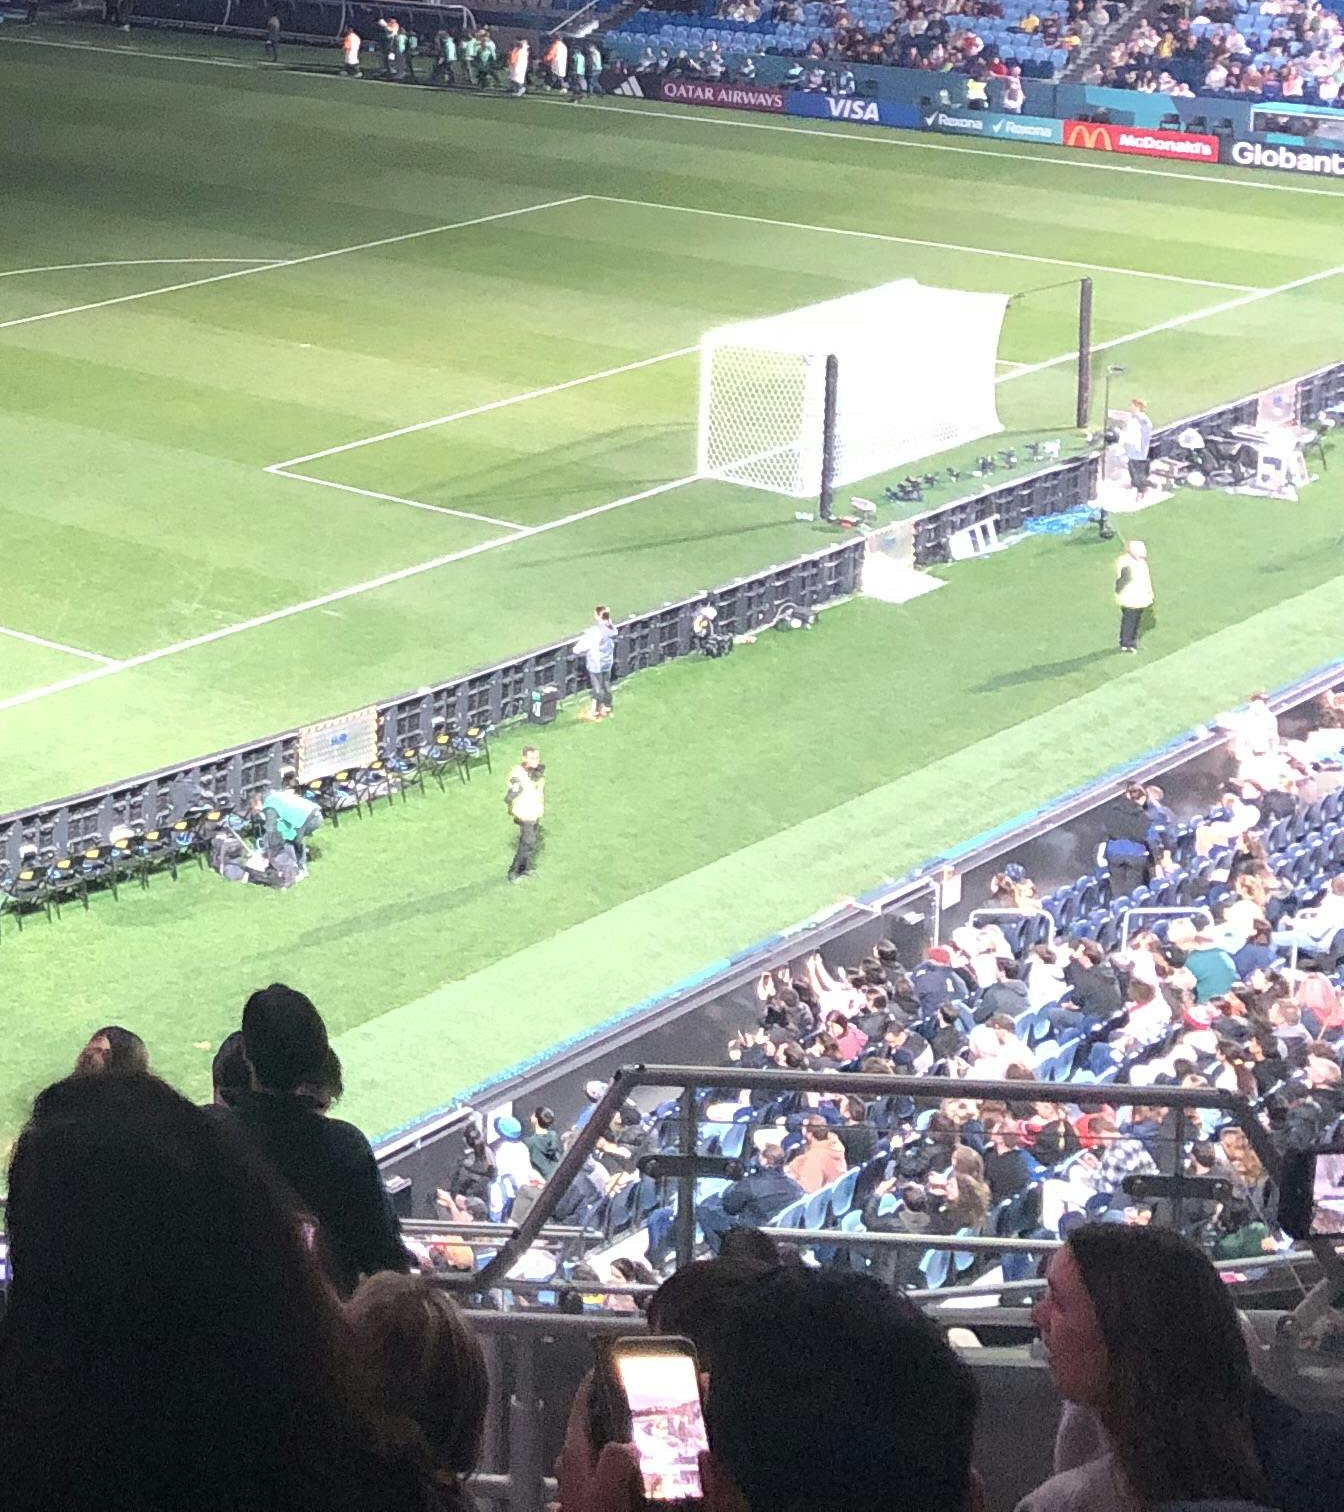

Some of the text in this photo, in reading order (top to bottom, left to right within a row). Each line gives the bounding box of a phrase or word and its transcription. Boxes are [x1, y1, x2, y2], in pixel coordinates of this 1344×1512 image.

[663, 82, 784, 108] QATAR AIRWAYS
[824, 96, 881, 122] VISA
[938, 113, 984, 131] Rexona
[1005, 120, 1053, 138] Rexona
[1119, 133, 1213, 157] McDonald's
[1231, 141, 1344, 175] Globant
